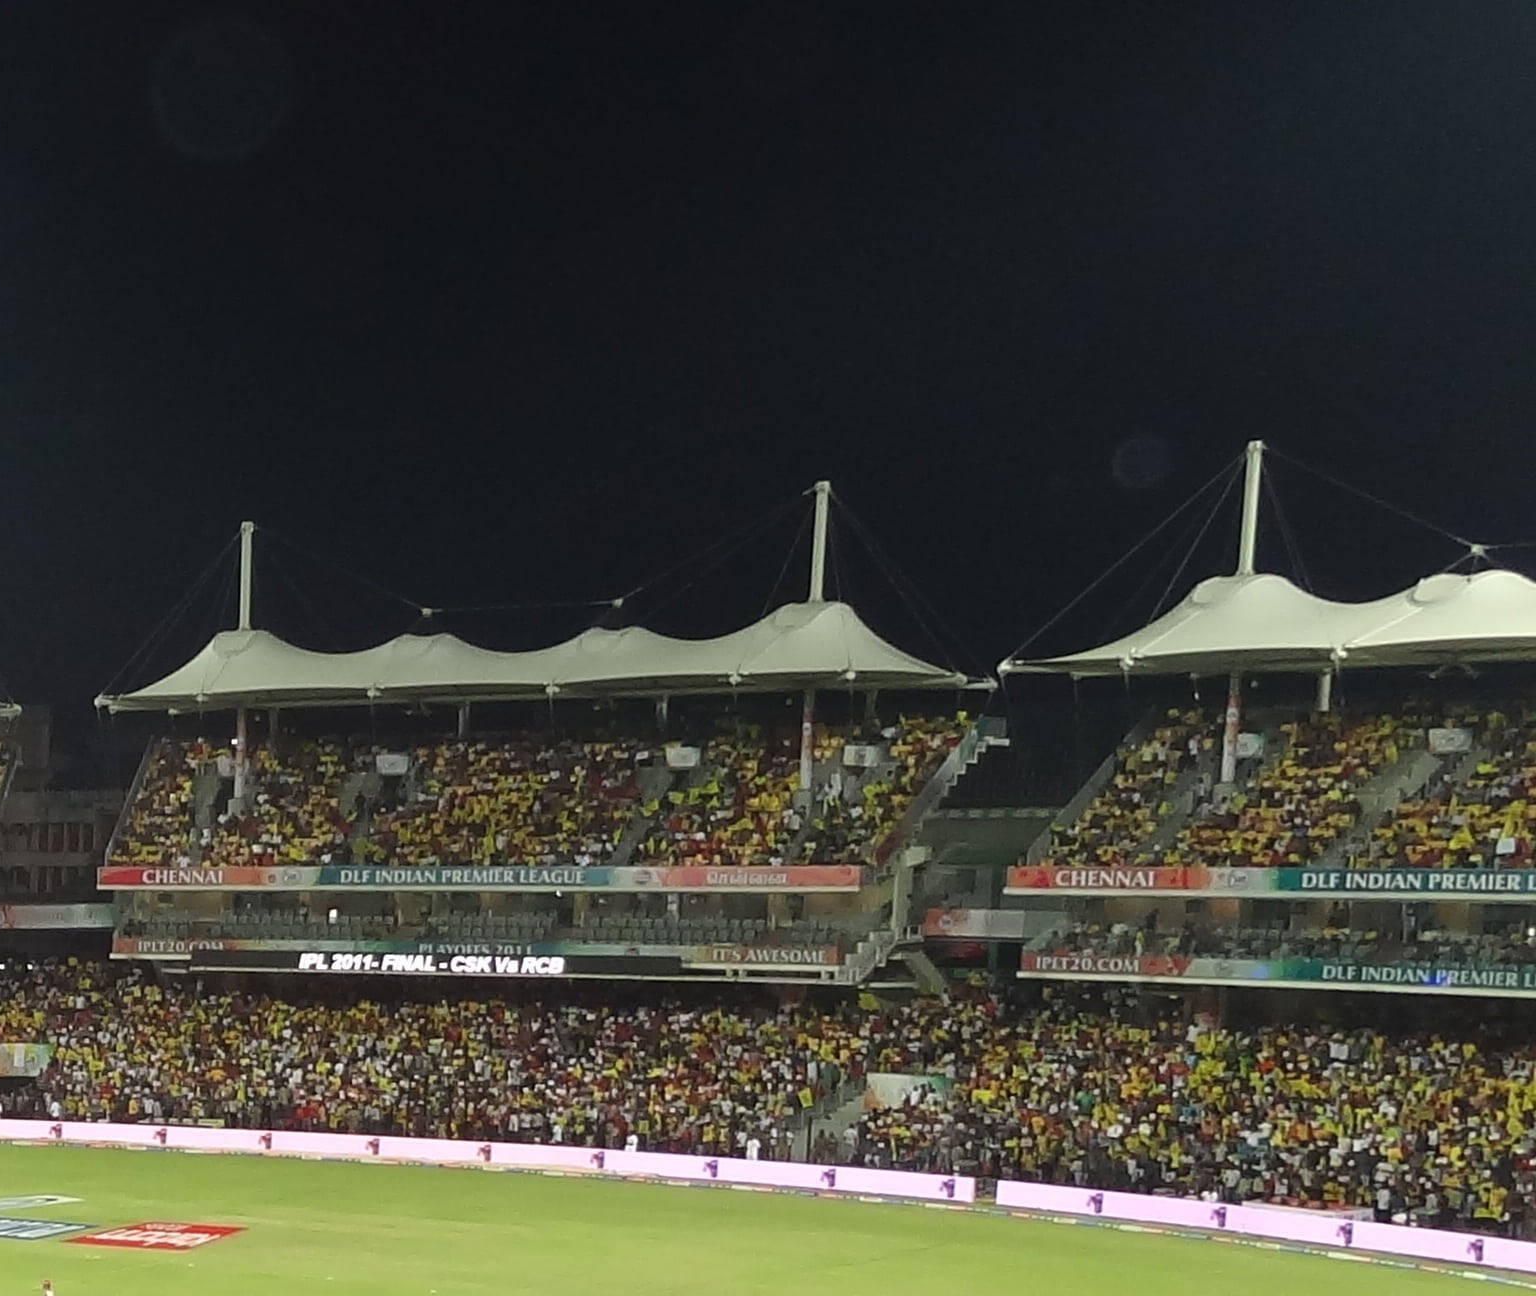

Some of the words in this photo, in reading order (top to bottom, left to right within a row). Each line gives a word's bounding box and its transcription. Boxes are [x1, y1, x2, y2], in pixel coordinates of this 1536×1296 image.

[141, 869, 224, 884] CHENNAI
[340, 869, 371, 884] DLF
[375, 870, 437, 884] INDIAN
[441, 870, 515, 884] PREMIER
[519, 870, 586, 885] LEAGUE
[1055, 870, 1155, 887] CHENNAI
[1302, 872, 1341, 889] DLF
[1345, 873, 1422, 889] INDIAN
[1428, 873, 1521, 890] PREMIER
[298, 953, 328, 970] IPL
[381, 955, 436, 972] FINAL
[451, 956, 491, 973] CSK
[521, 957, 565, 974] RCB
[712, 949, 741, 962] IT'S
[745, 949, 826, 963] AWESOME
[1036, 956, 1140, 973] IPLT20.COM
[1322, 965, 1357, 980] DLF
[1361, 966, 1429, 983] INDIAN
[1436, 969, 1518, 987] PREMIER
